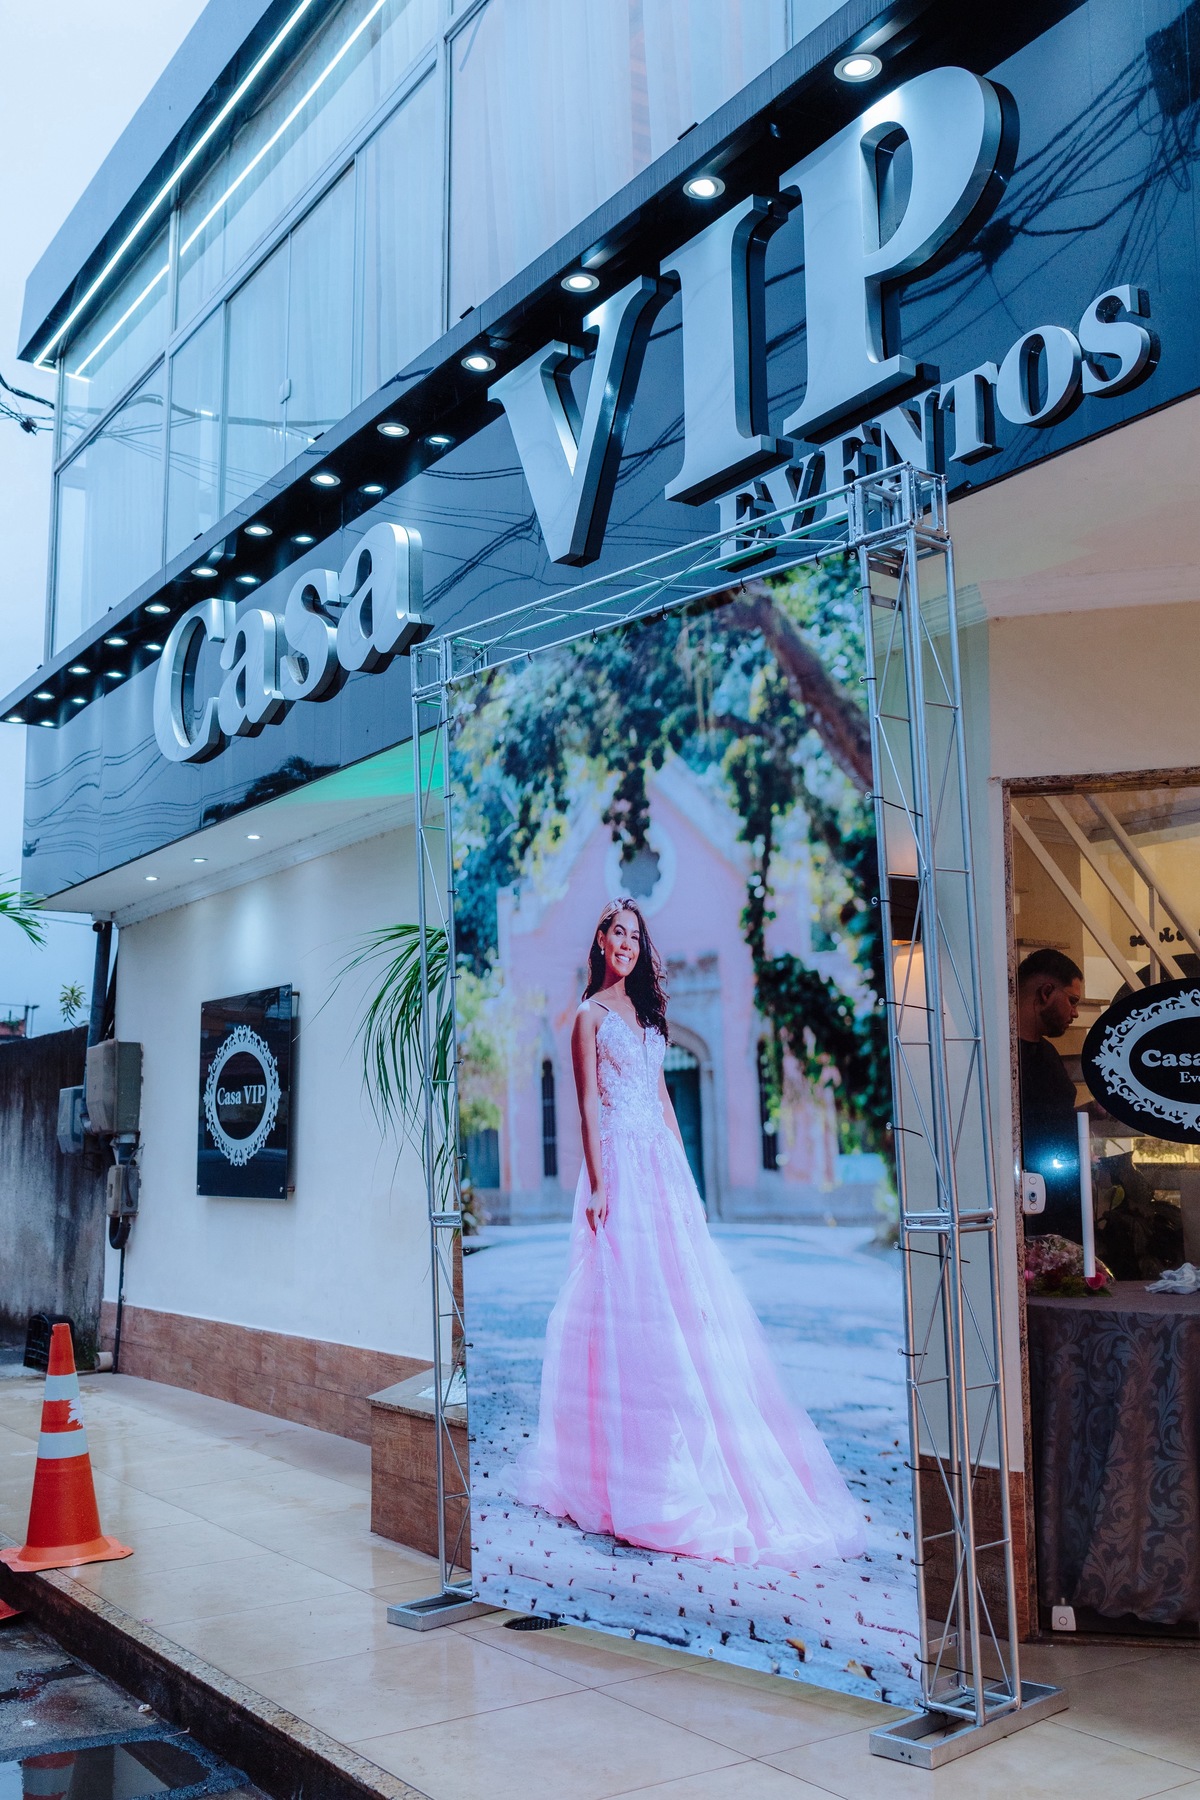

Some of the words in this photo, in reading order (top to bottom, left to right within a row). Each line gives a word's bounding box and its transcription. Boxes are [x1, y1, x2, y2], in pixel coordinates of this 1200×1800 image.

[153, 522, 433, 762] Casa
[488, 66, 1018, 566] VIP
[715, 284, 1160, 569] EVENTOS
[217, 1087, 242, 1106] Casa
[243, 1085, 266, 1104] VIP
